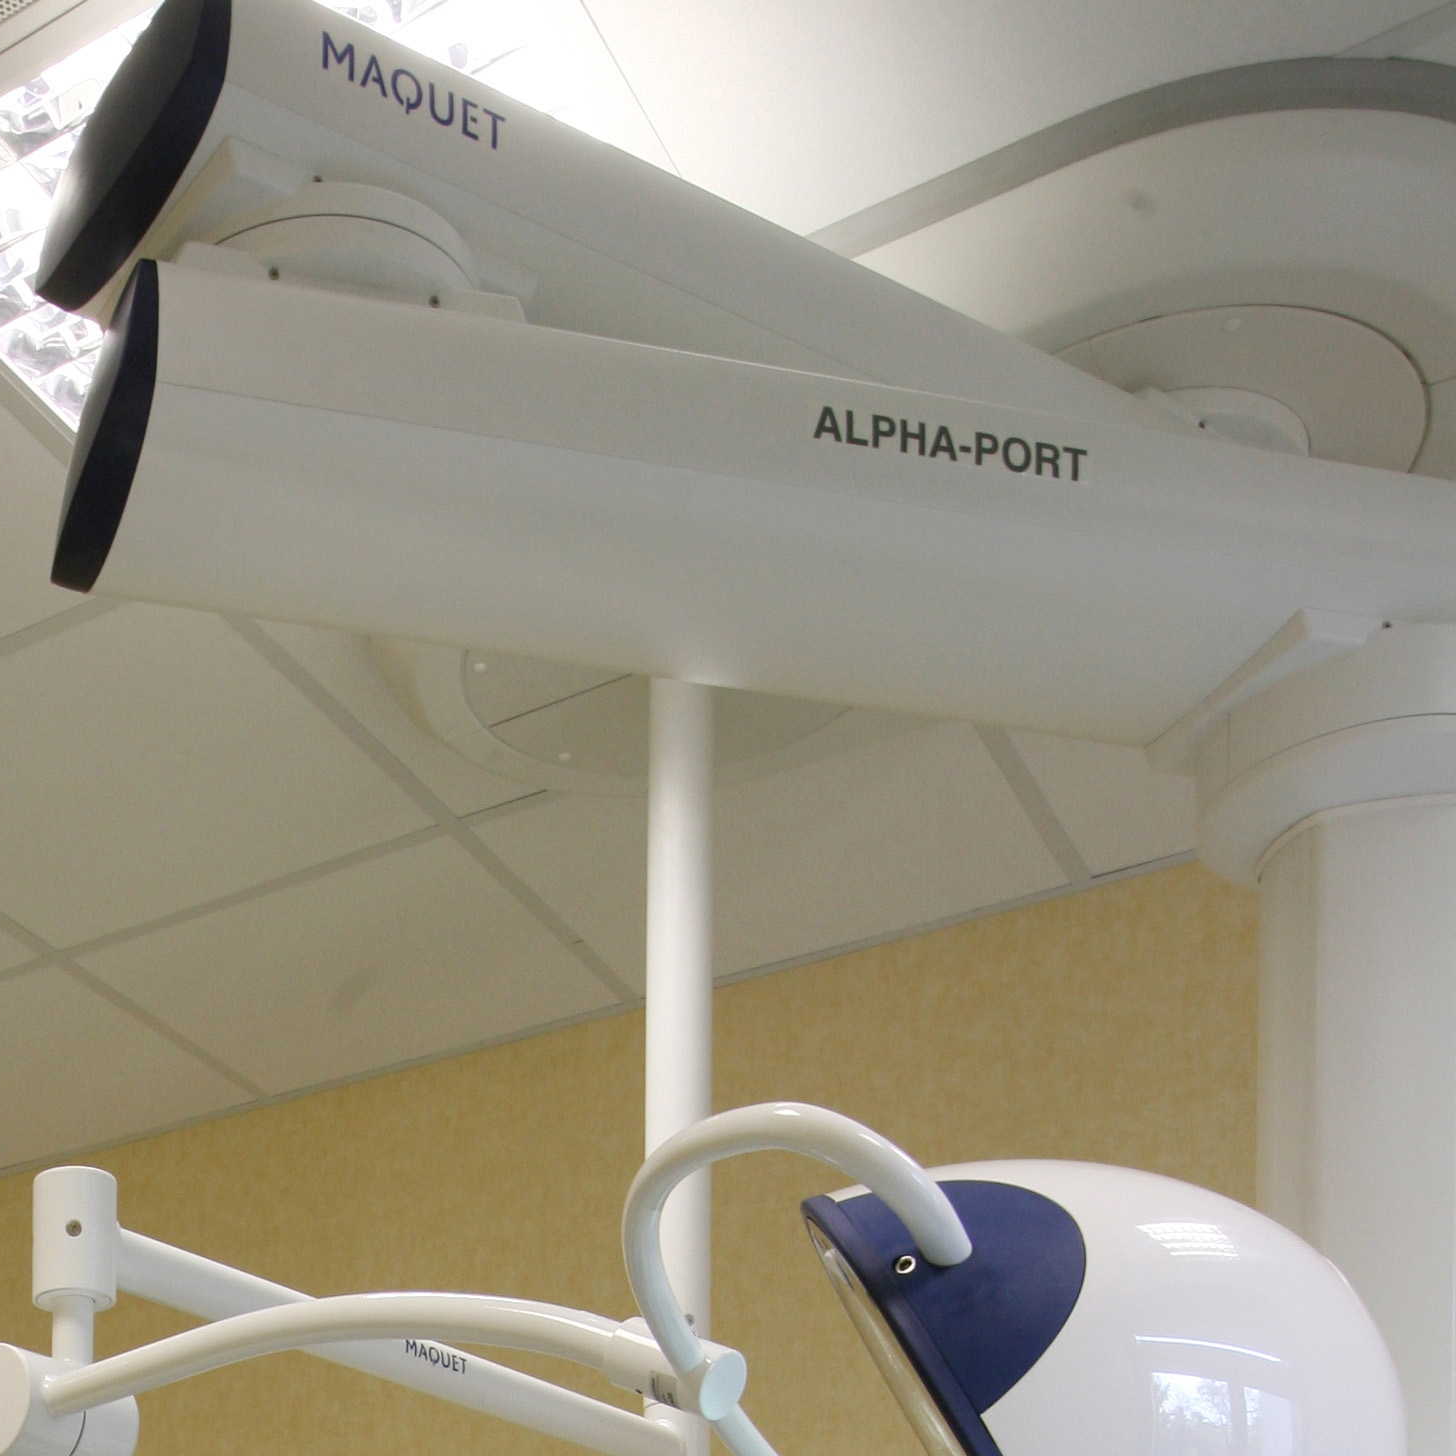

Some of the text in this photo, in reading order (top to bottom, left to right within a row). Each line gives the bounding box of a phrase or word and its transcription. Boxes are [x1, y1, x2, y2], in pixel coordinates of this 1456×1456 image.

[320, 29, 507, 152] MAQUET
[812, 405, 1089, 484] ALPHA-PORT
[404, 1338, 468, 1375] MAQUET
